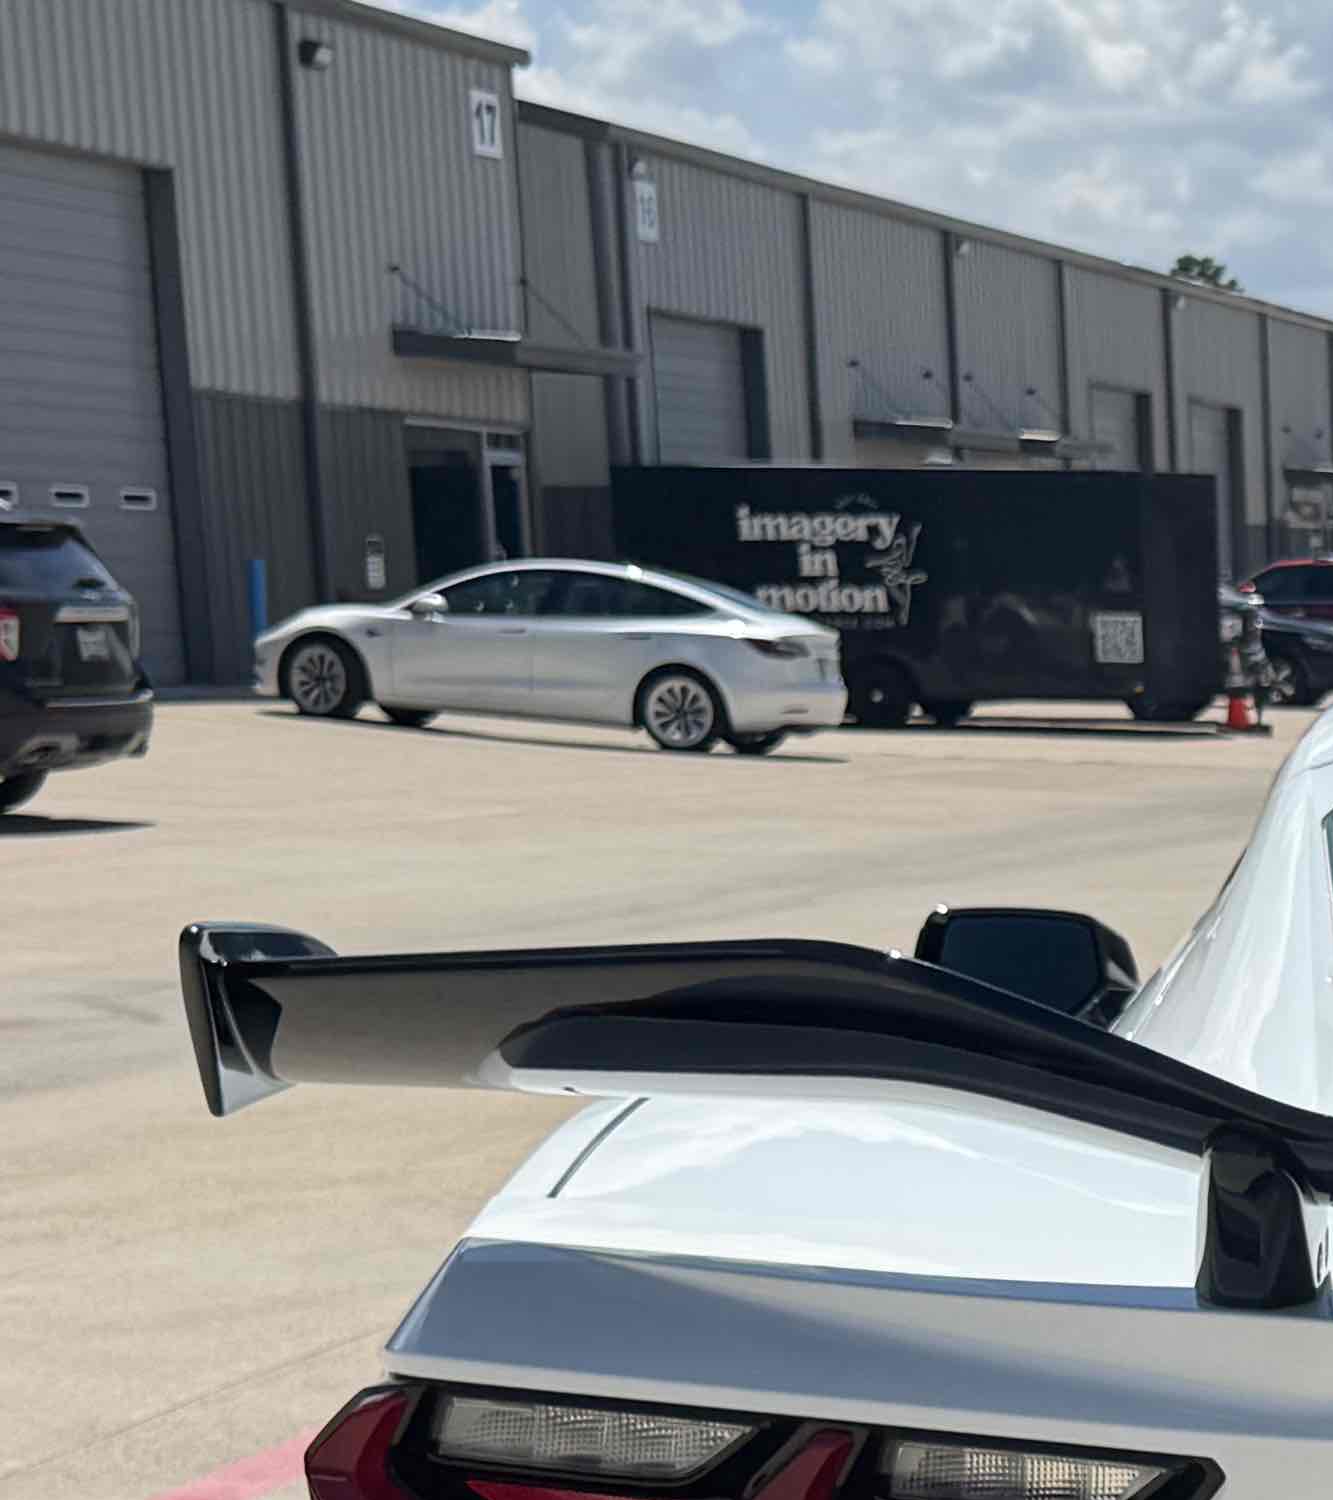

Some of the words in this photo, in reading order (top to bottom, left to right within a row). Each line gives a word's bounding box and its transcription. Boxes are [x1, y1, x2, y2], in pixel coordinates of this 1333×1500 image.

[475, 101, 497, 147] 17
[736, 503, 901, 550] imagery
[798, 543, 840, 577] in
[756, 578, 890, 613] motion
